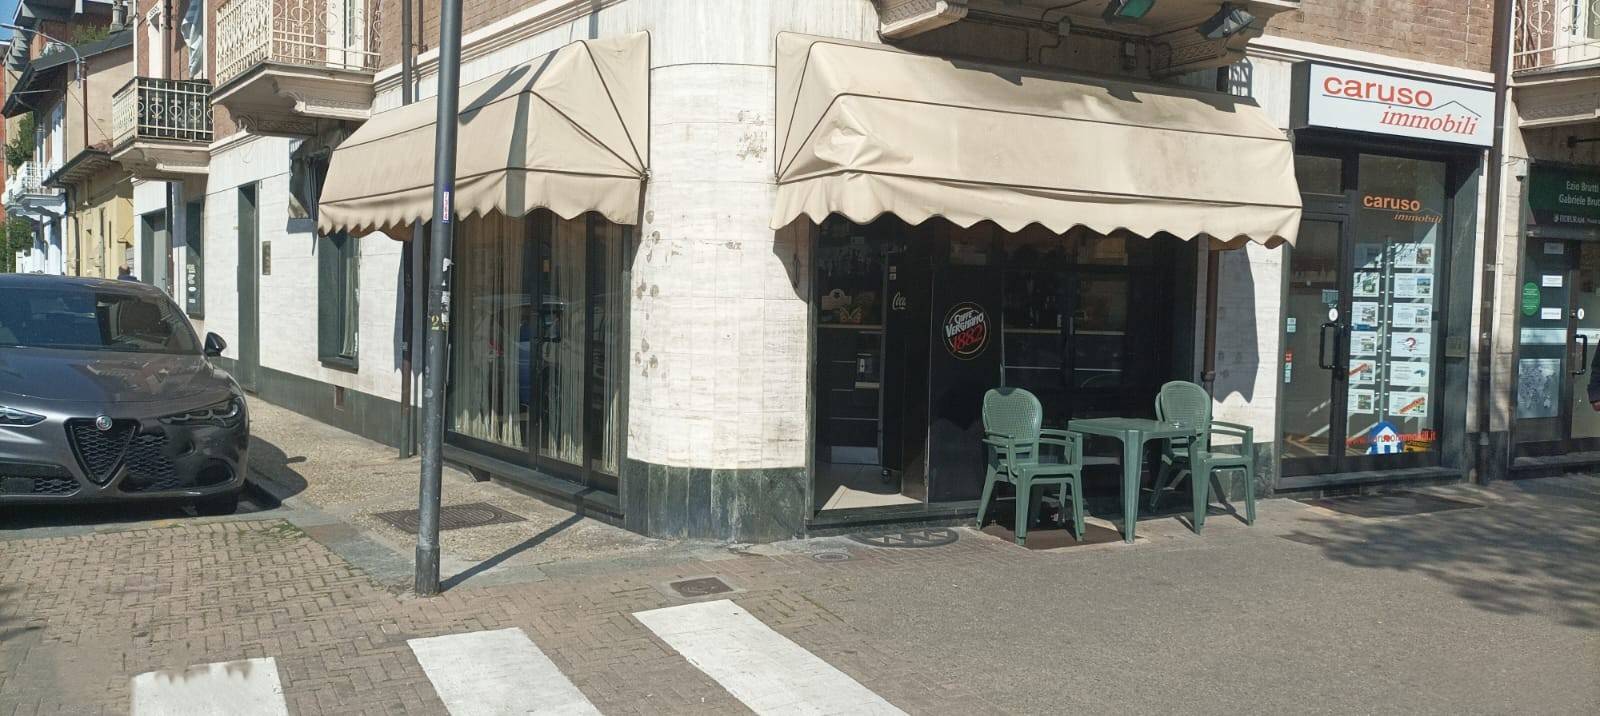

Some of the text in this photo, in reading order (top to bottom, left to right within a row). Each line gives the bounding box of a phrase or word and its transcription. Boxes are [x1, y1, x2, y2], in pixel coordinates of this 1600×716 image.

[1323, 76, 1433, 108] caruso
[1379, 105, 1479, 136] immobili
[1363, 195, 1421, 211] caruso
[1394, 211, 1443, 224] immobili
